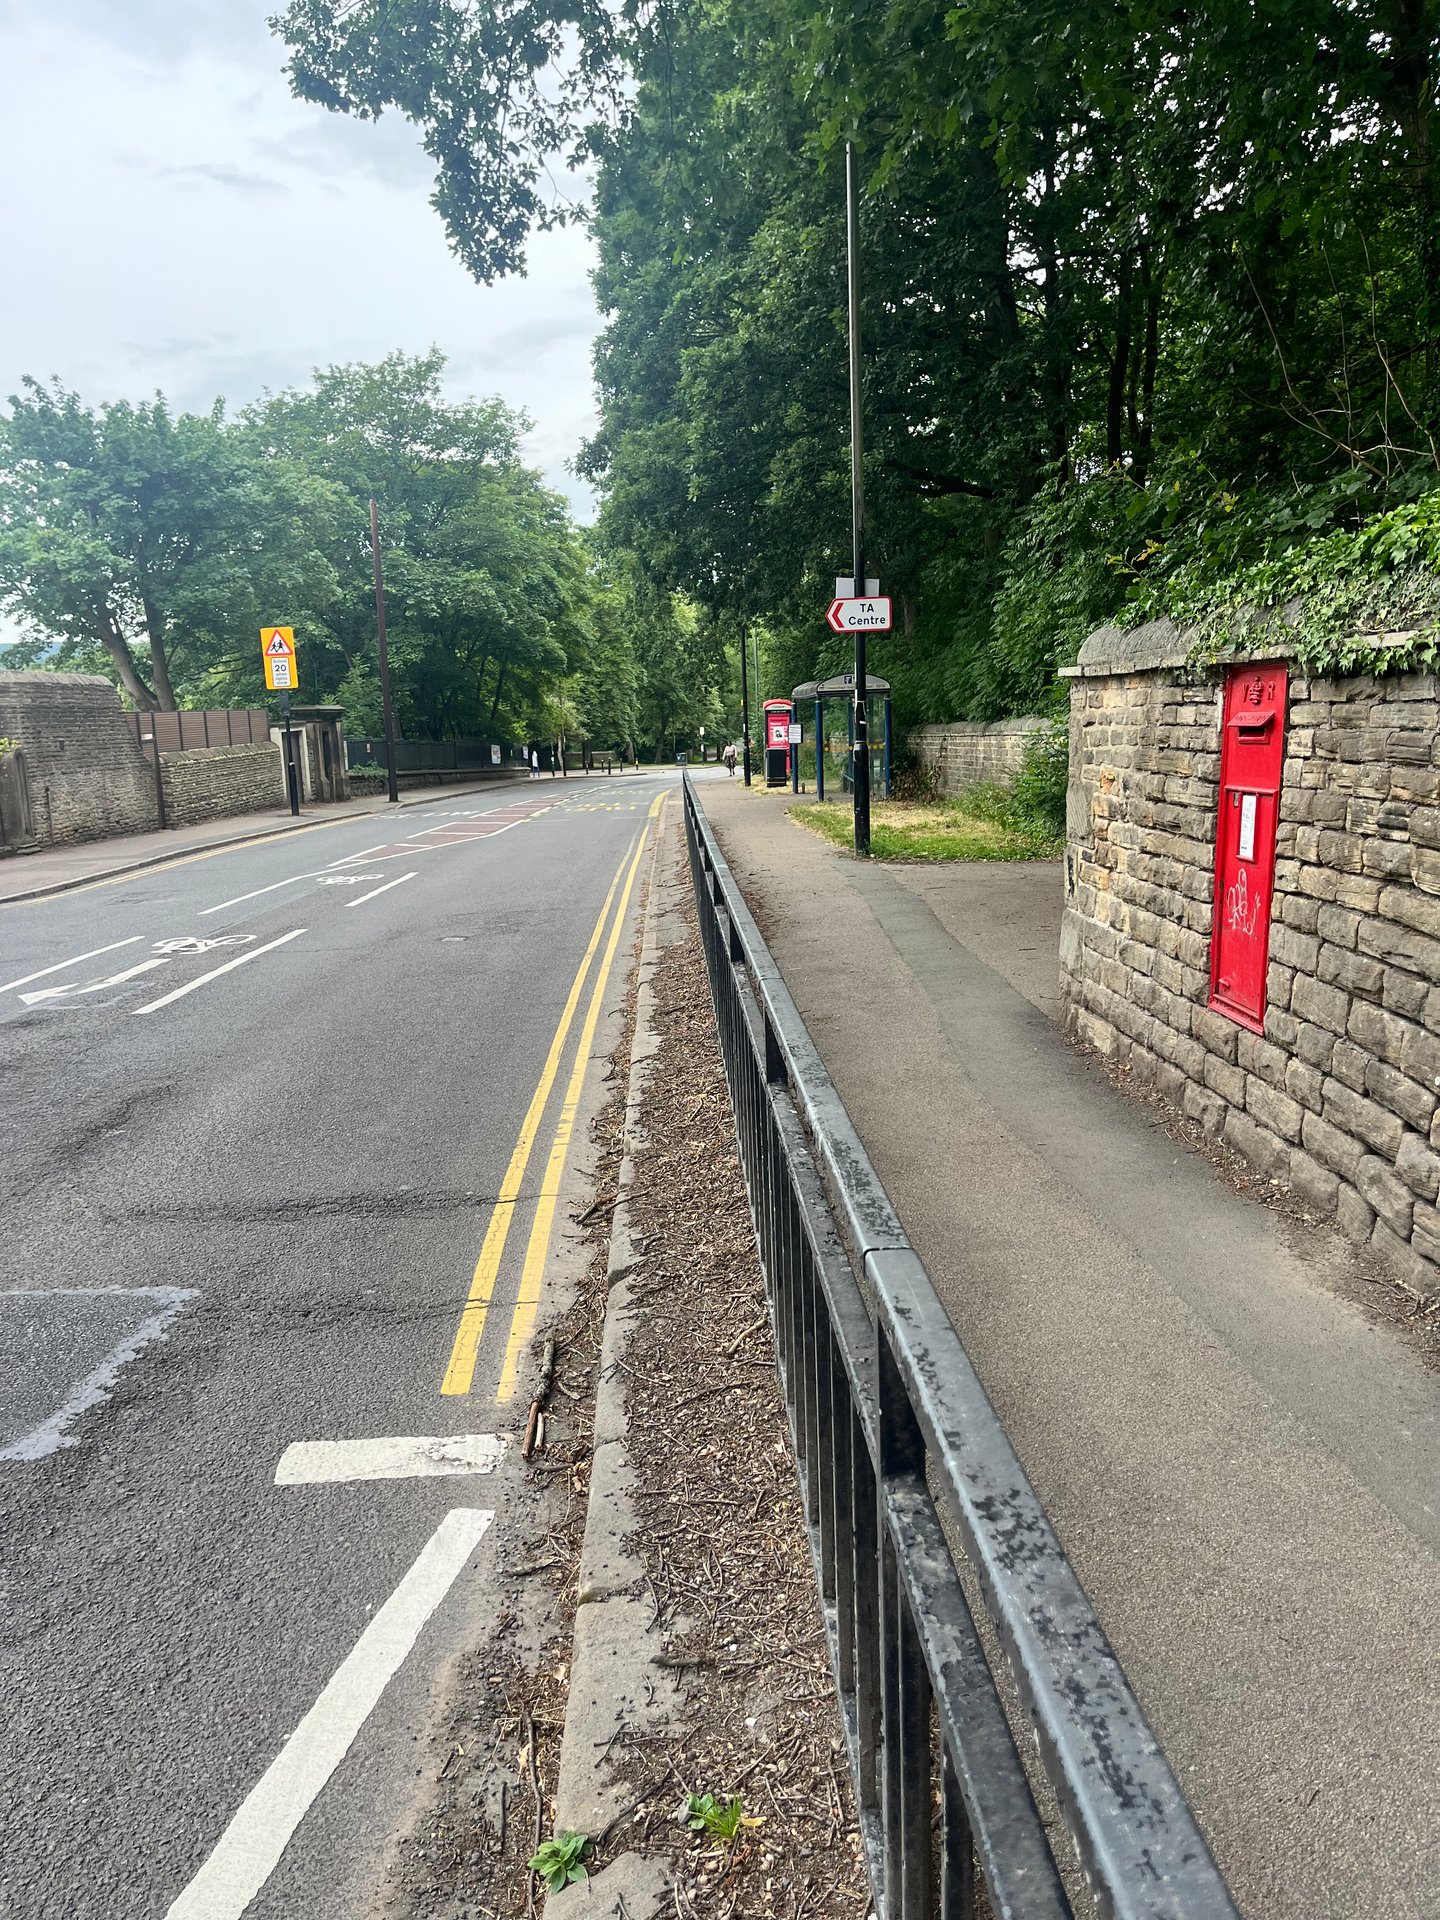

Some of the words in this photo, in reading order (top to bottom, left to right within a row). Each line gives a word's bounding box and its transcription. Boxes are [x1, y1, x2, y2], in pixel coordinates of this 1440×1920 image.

[859, 603, 875, 613] TA
[848, 616, 886, 626] Centre
[274, 664, 287, 672] 20
